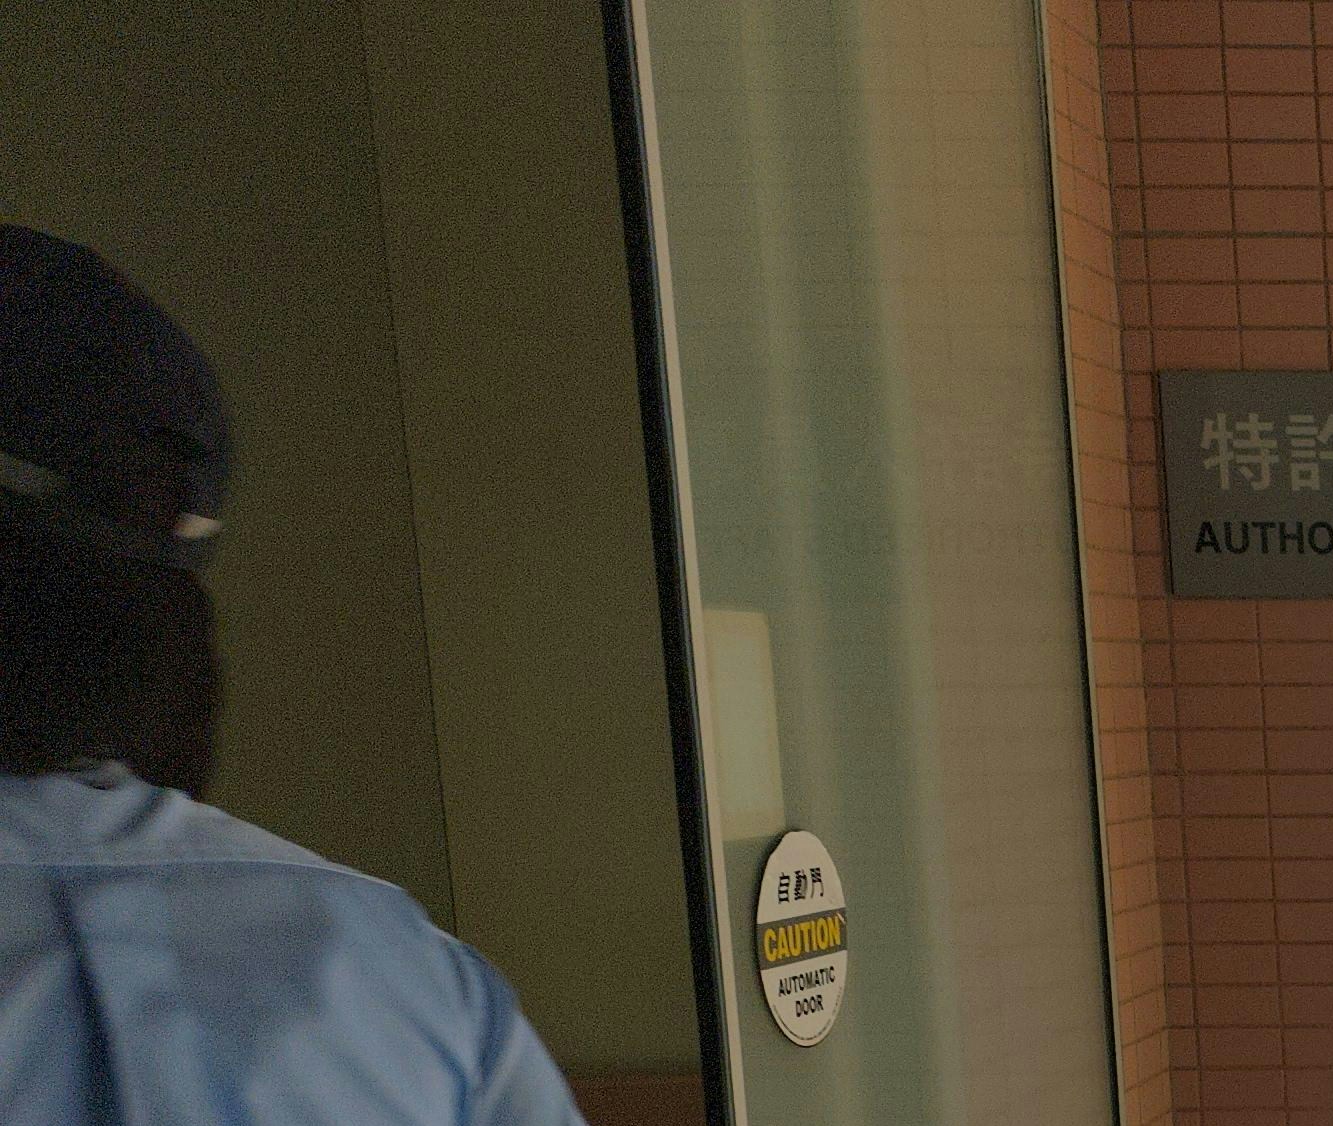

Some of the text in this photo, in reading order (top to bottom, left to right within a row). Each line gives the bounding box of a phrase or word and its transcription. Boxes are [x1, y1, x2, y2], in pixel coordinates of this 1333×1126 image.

[777, 866, 825, 905] 自動門
[763, 916, 841, 962] CAUTION
[778, 965, 836, 998] AUTOMATIC
[795, 994, 824, 1018] DOOR
